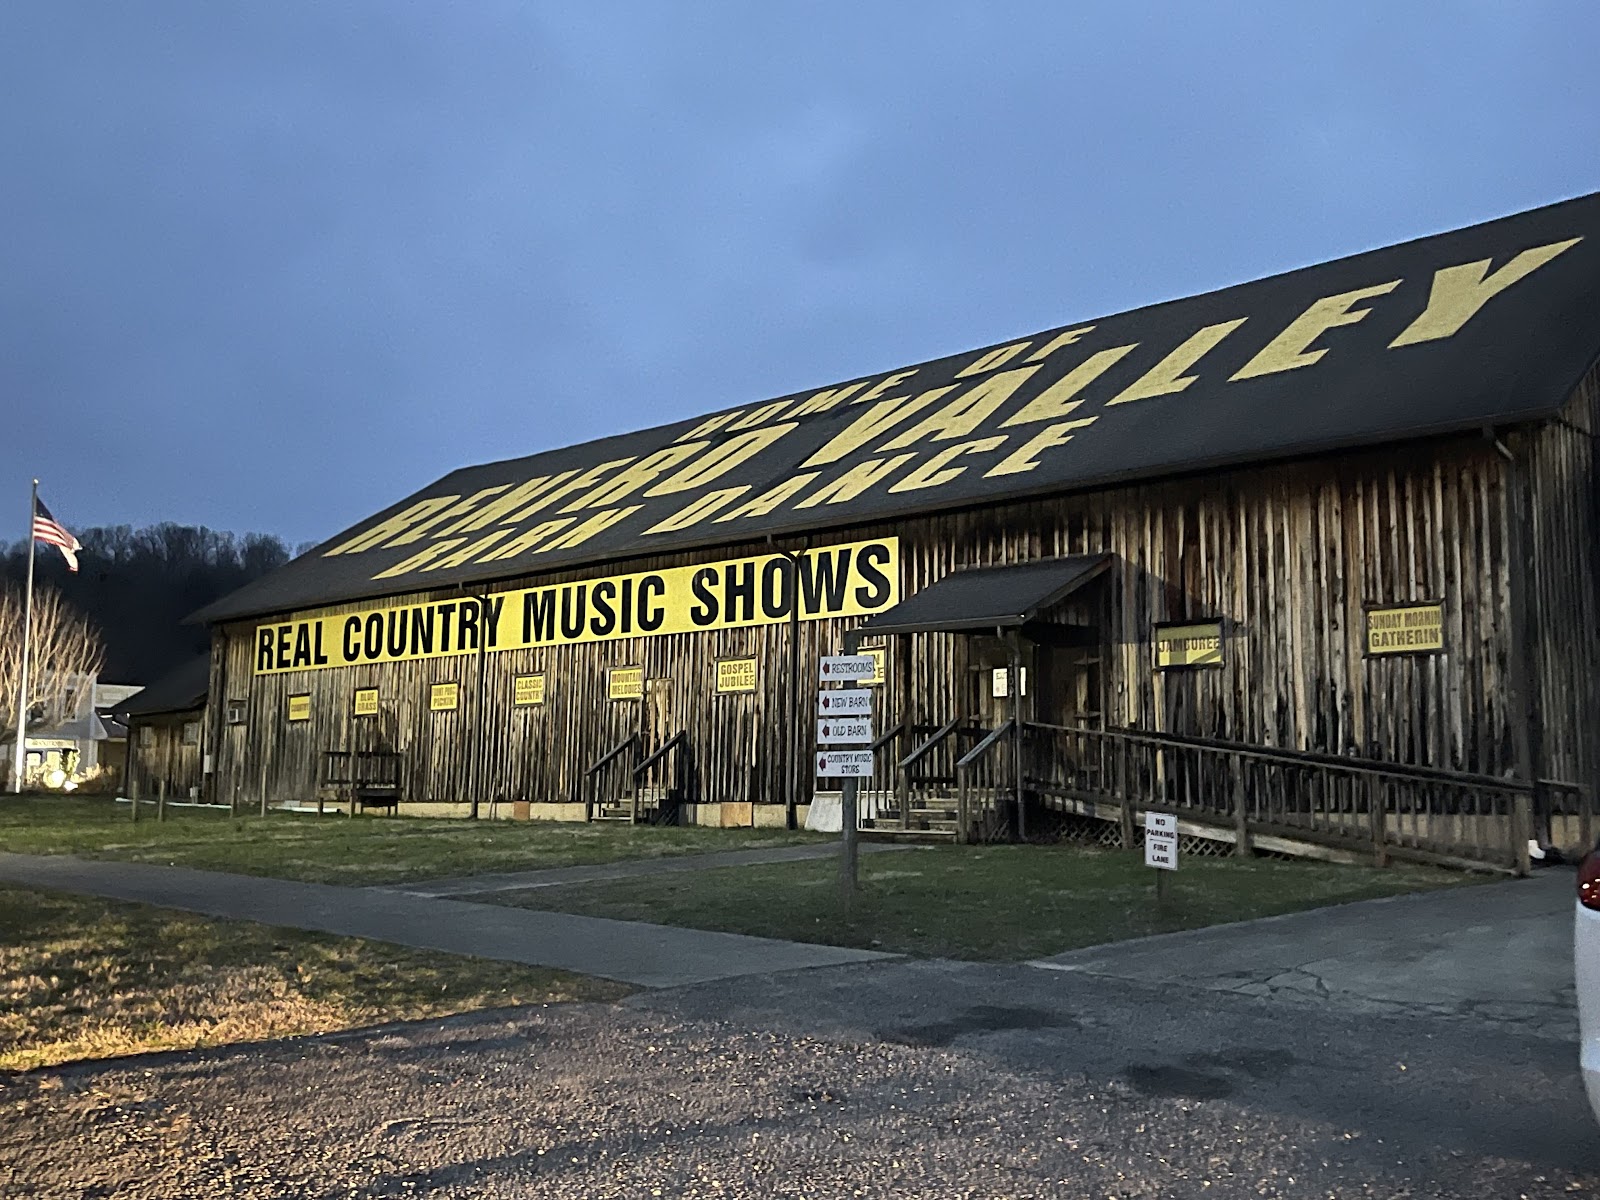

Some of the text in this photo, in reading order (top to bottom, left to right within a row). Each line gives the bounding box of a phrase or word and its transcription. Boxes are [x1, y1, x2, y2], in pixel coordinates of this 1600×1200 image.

[674, 326, 1097, 442] HOME OF
[322, 236, 1584, 557] RENFRO VALLEY
[371, 416, 1099, 580] BARN DANCE
[257, 543, 891, 671] REAL COUNTRY MUSIC SHOWS
[1368, 612, 1402, 630] SUNDAY
[1158, 636, 1220, 653] JAMBOREE
[720, 662, 754, 675] GOSPEL
[831, 661, 873, 674] RESTROOMS
[517, 678, 543, 690] CLASSIC
[719, 675, 755, 688] JUBILEE
[831, 696, 869, 708] NEW BARN
[832, 725, 867, 736] OLD BARN
[827, 753, 872, 764] COUNTRY MUSIC
[841, 764, 860, 774] STORE
[1155, 818, 1166, 826] NO
[1146, 829, 1175, 839] PARKING
[1153, 843, 1168, 852] FIRE
[1152, 855, 1169, 864] LANE
